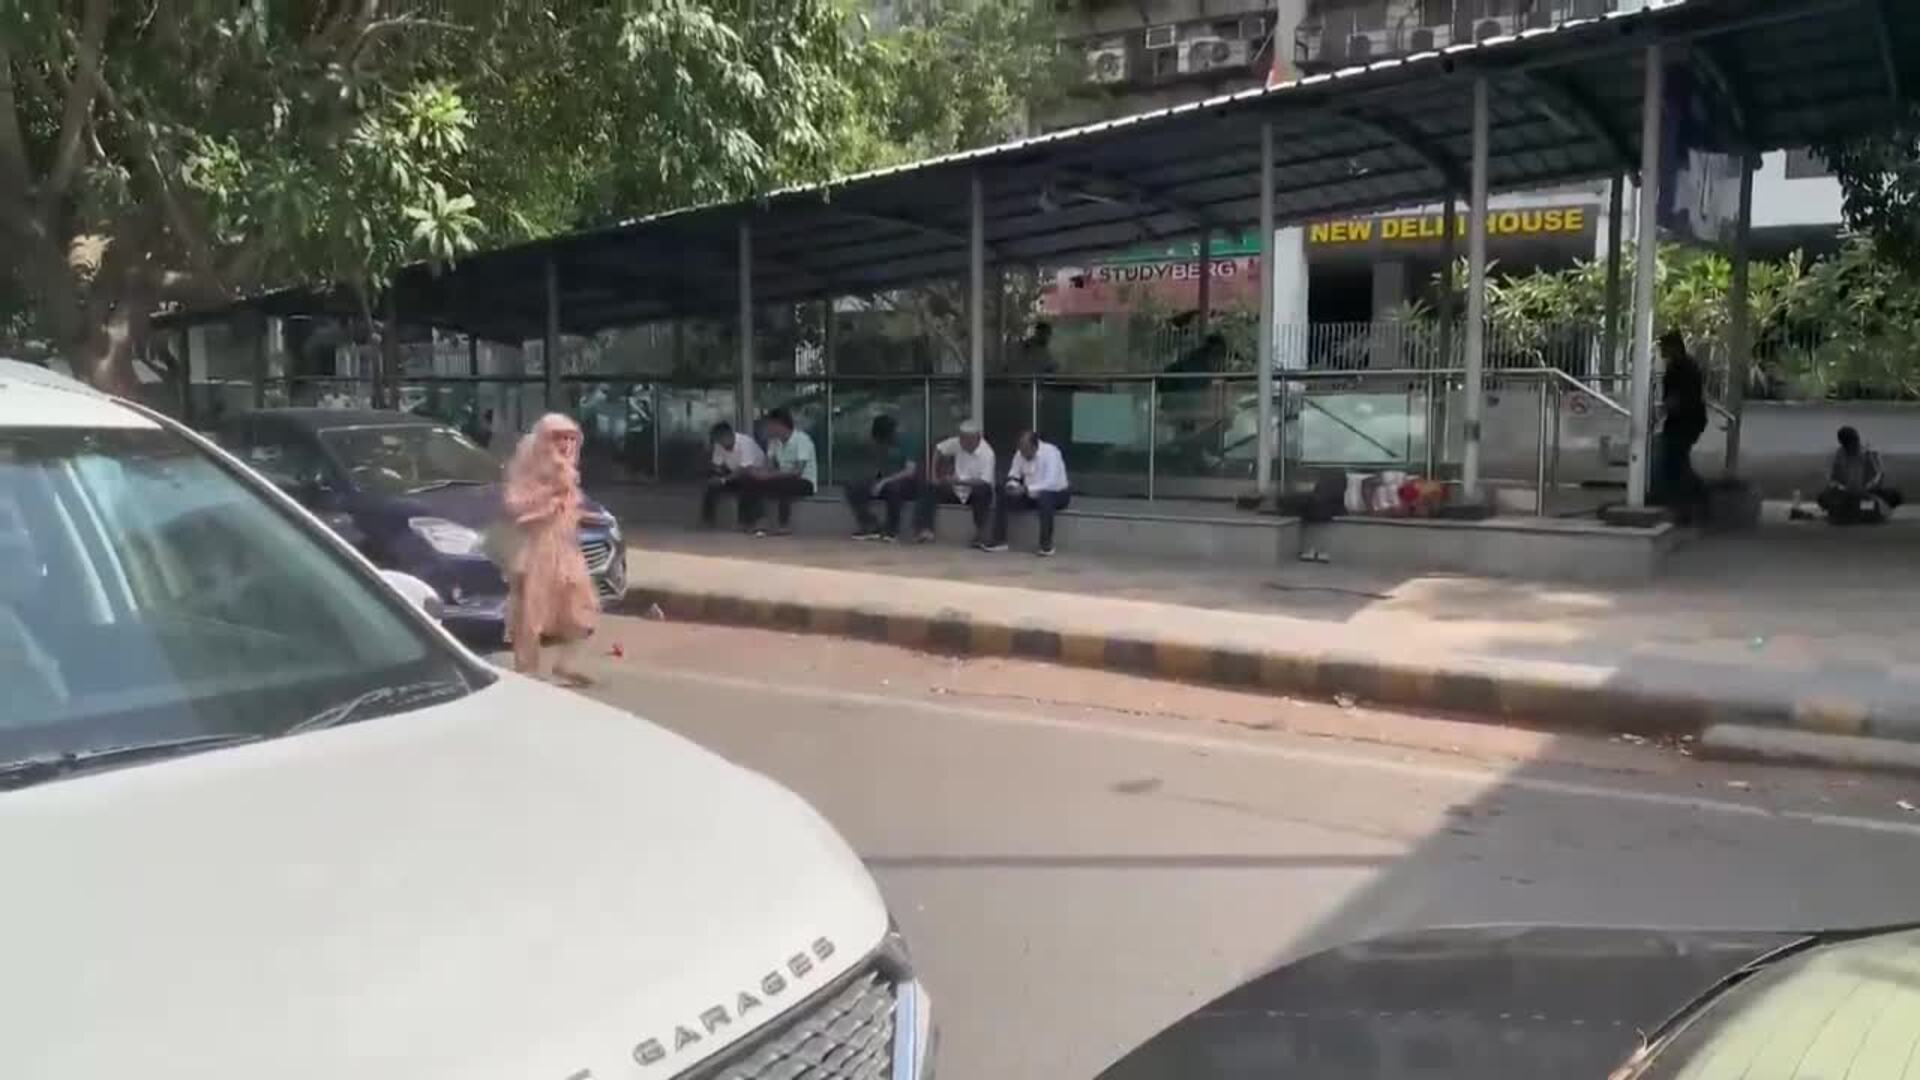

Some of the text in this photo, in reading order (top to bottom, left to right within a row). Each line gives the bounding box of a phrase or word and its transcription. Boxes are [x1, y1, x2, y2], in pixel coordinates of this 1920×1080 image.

[1310, 220, 1371, 242] NEW
[1099, 261, 1237, 282] STUDYBERG
[632, 935, 836, 1066] GARAGES
